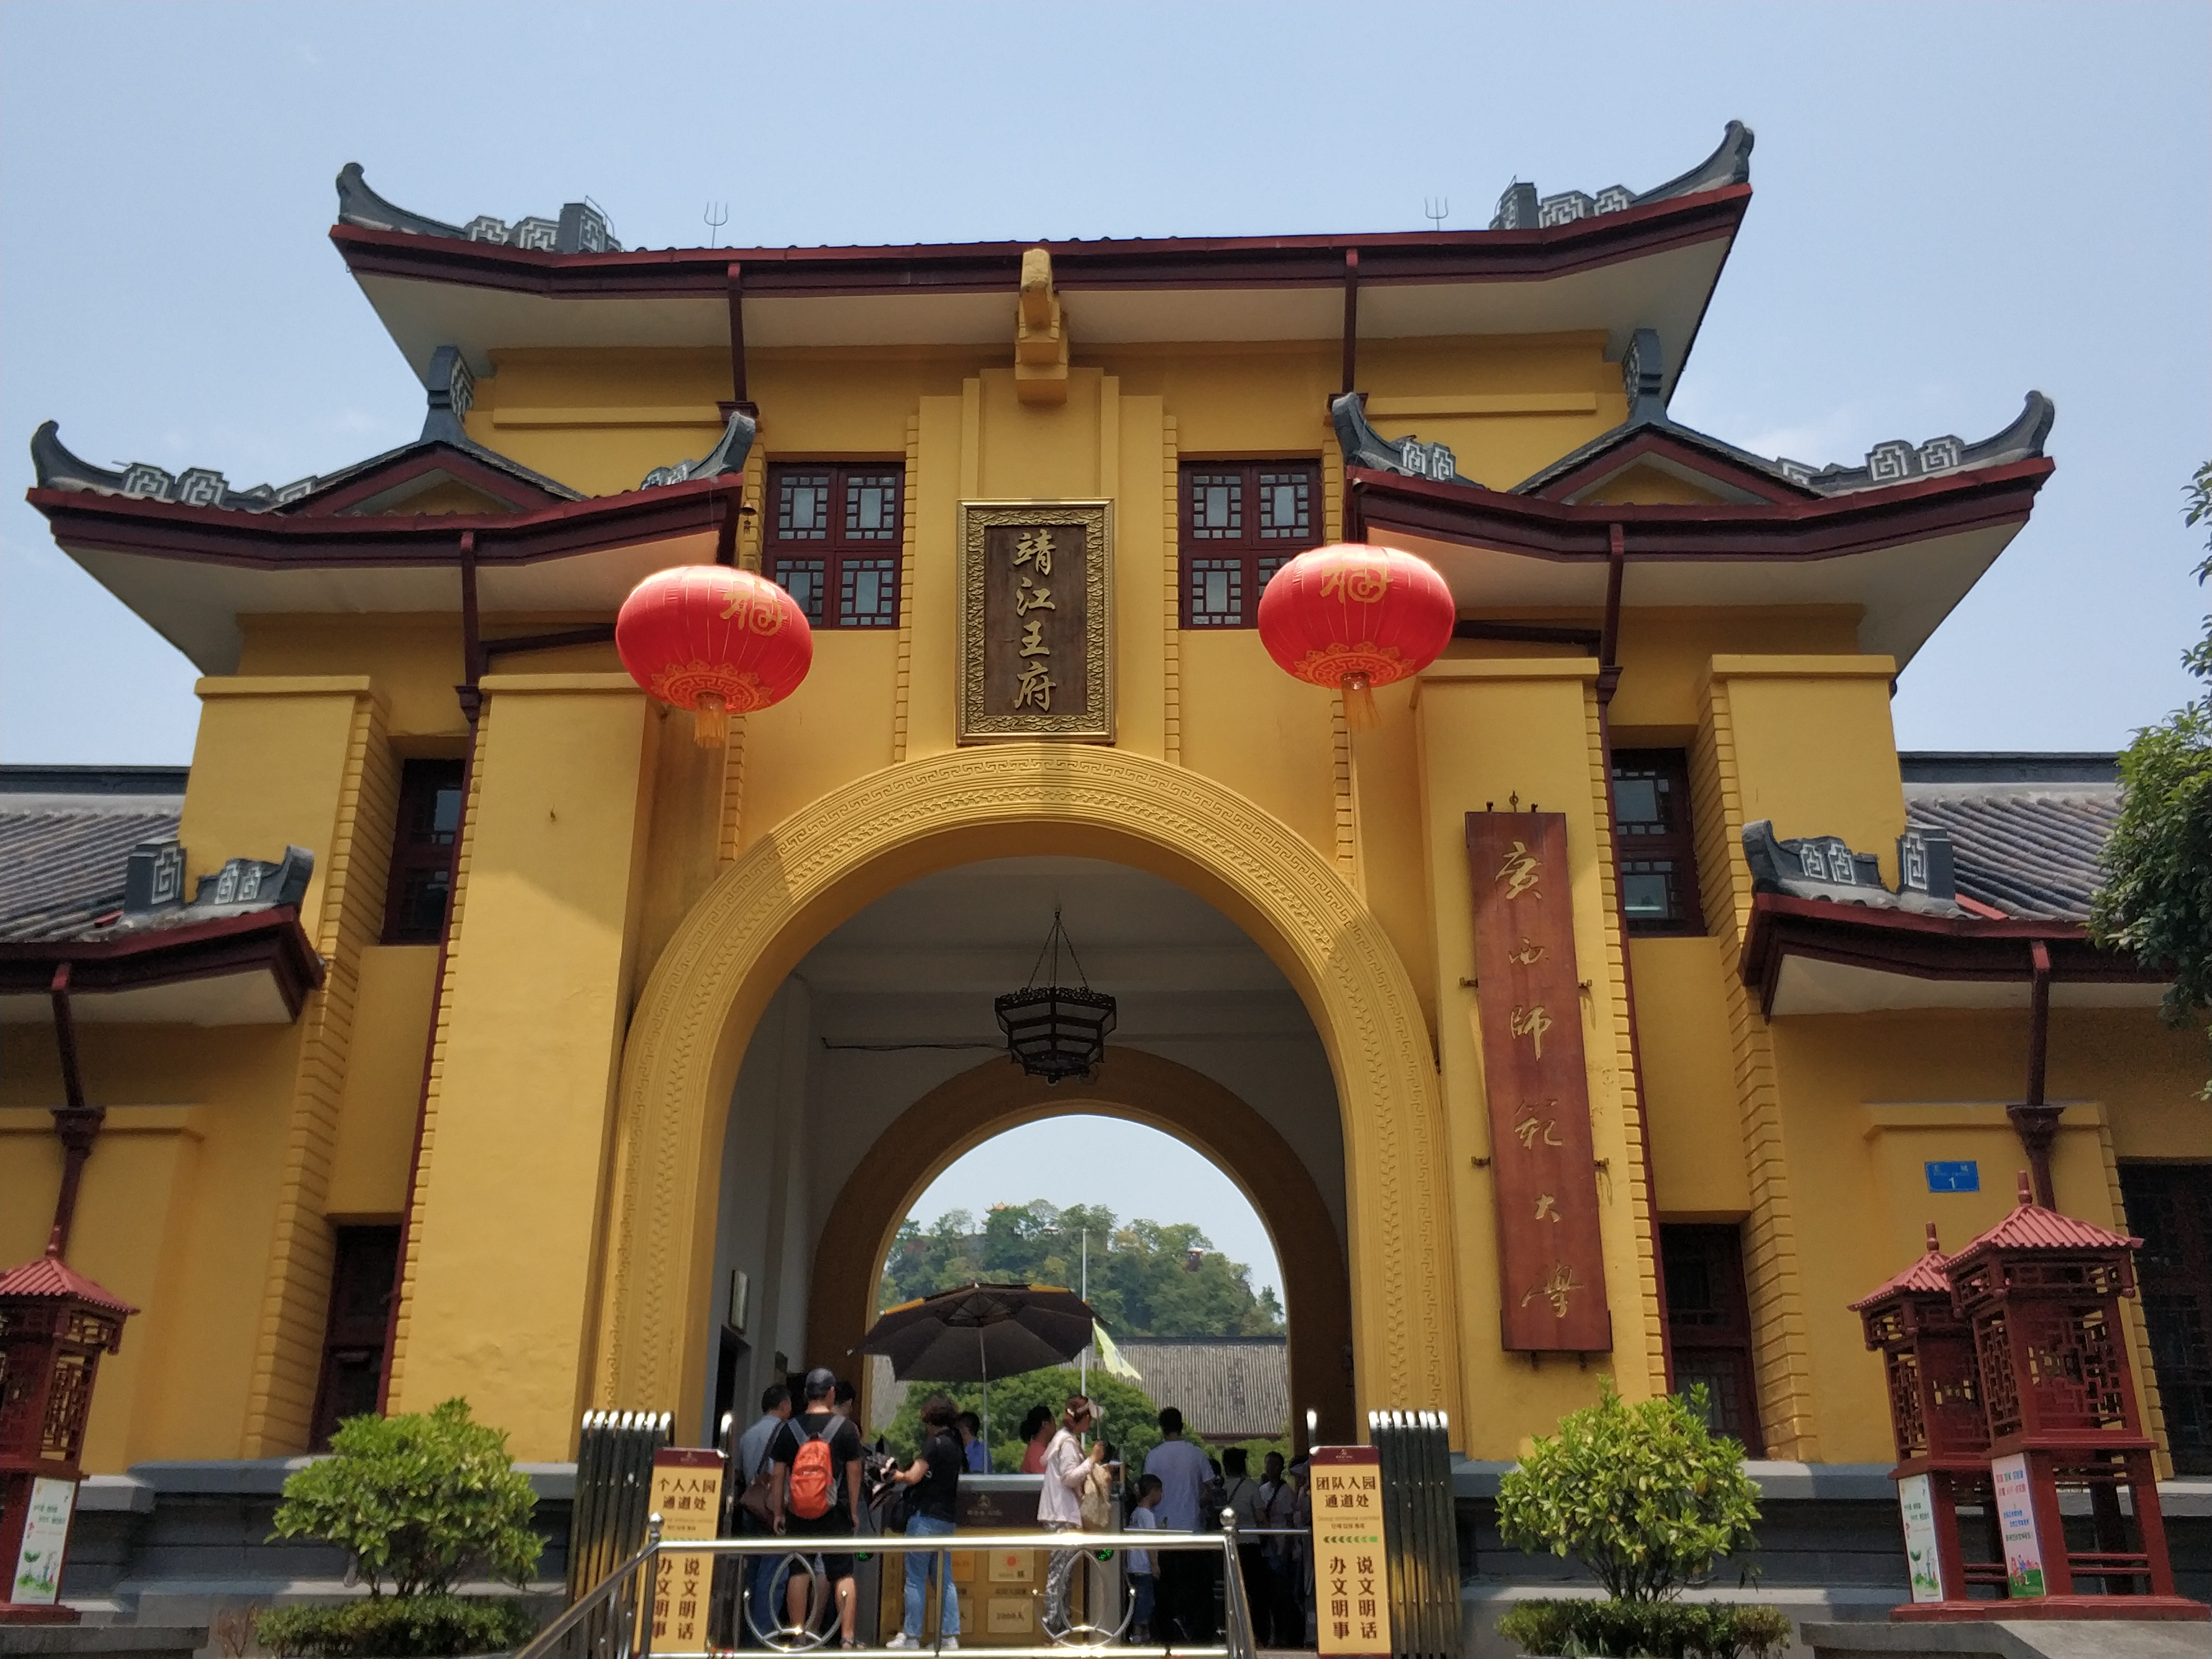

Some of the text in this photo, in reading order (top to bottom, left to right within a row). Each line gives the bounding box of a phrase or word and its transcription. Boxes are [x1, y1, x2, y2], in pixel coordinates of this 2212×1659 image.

[1319, 560, 1394, 604] 福
[719, 581, 788, 637] 福
[1013, 529, 1056, 712] 靖江王府
[1948, 1177, 1955, 1190] 1
[658, 1477, 716, 1494] 个人入园
[663, 1495, 706, 1511] 通道处
[1316, 1476, 1376, 1490] 团队入园
[1325, 1494, 1369, 1508] 通道处
[678, 1557, 700, 1640] 说文明话
[1329, 1556, 1349, 1640] 办文明事
[1357, 1556, 1377, 1640] 说文明话
